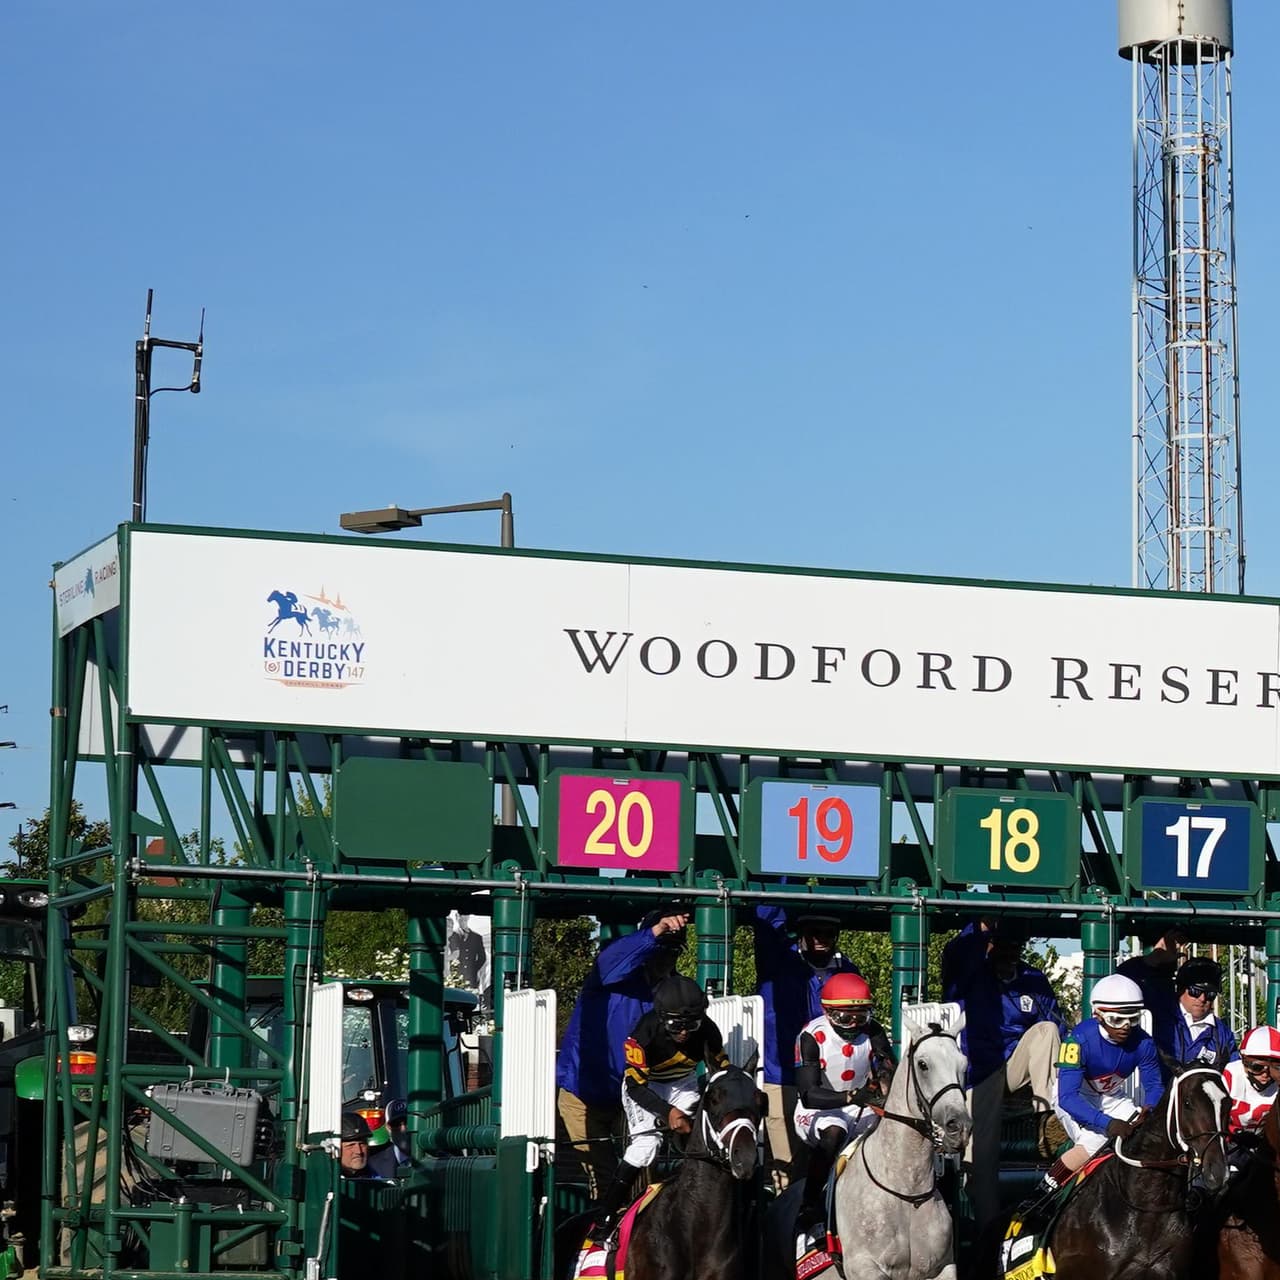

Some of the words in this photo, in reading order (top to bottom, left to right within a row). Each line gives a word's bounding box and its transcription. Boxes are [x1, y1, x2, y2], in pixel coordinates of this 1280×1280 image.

[264, 637, 365, 663] KENTUCKY
[284, 660, 345, 680] DERBY
[346, 666, 365, 678] 147
[563, 628, 1012, 693] WOODFORD
[585, 790, 653, 857] 20
[789, 798, 853, 862] 19
[980, 808, 1040, 872] 18
[1166, 816, 1227, 878] 17
[624, 1043, 644, 1065] 20
[1058, 1042, 1080, 1065] 18
